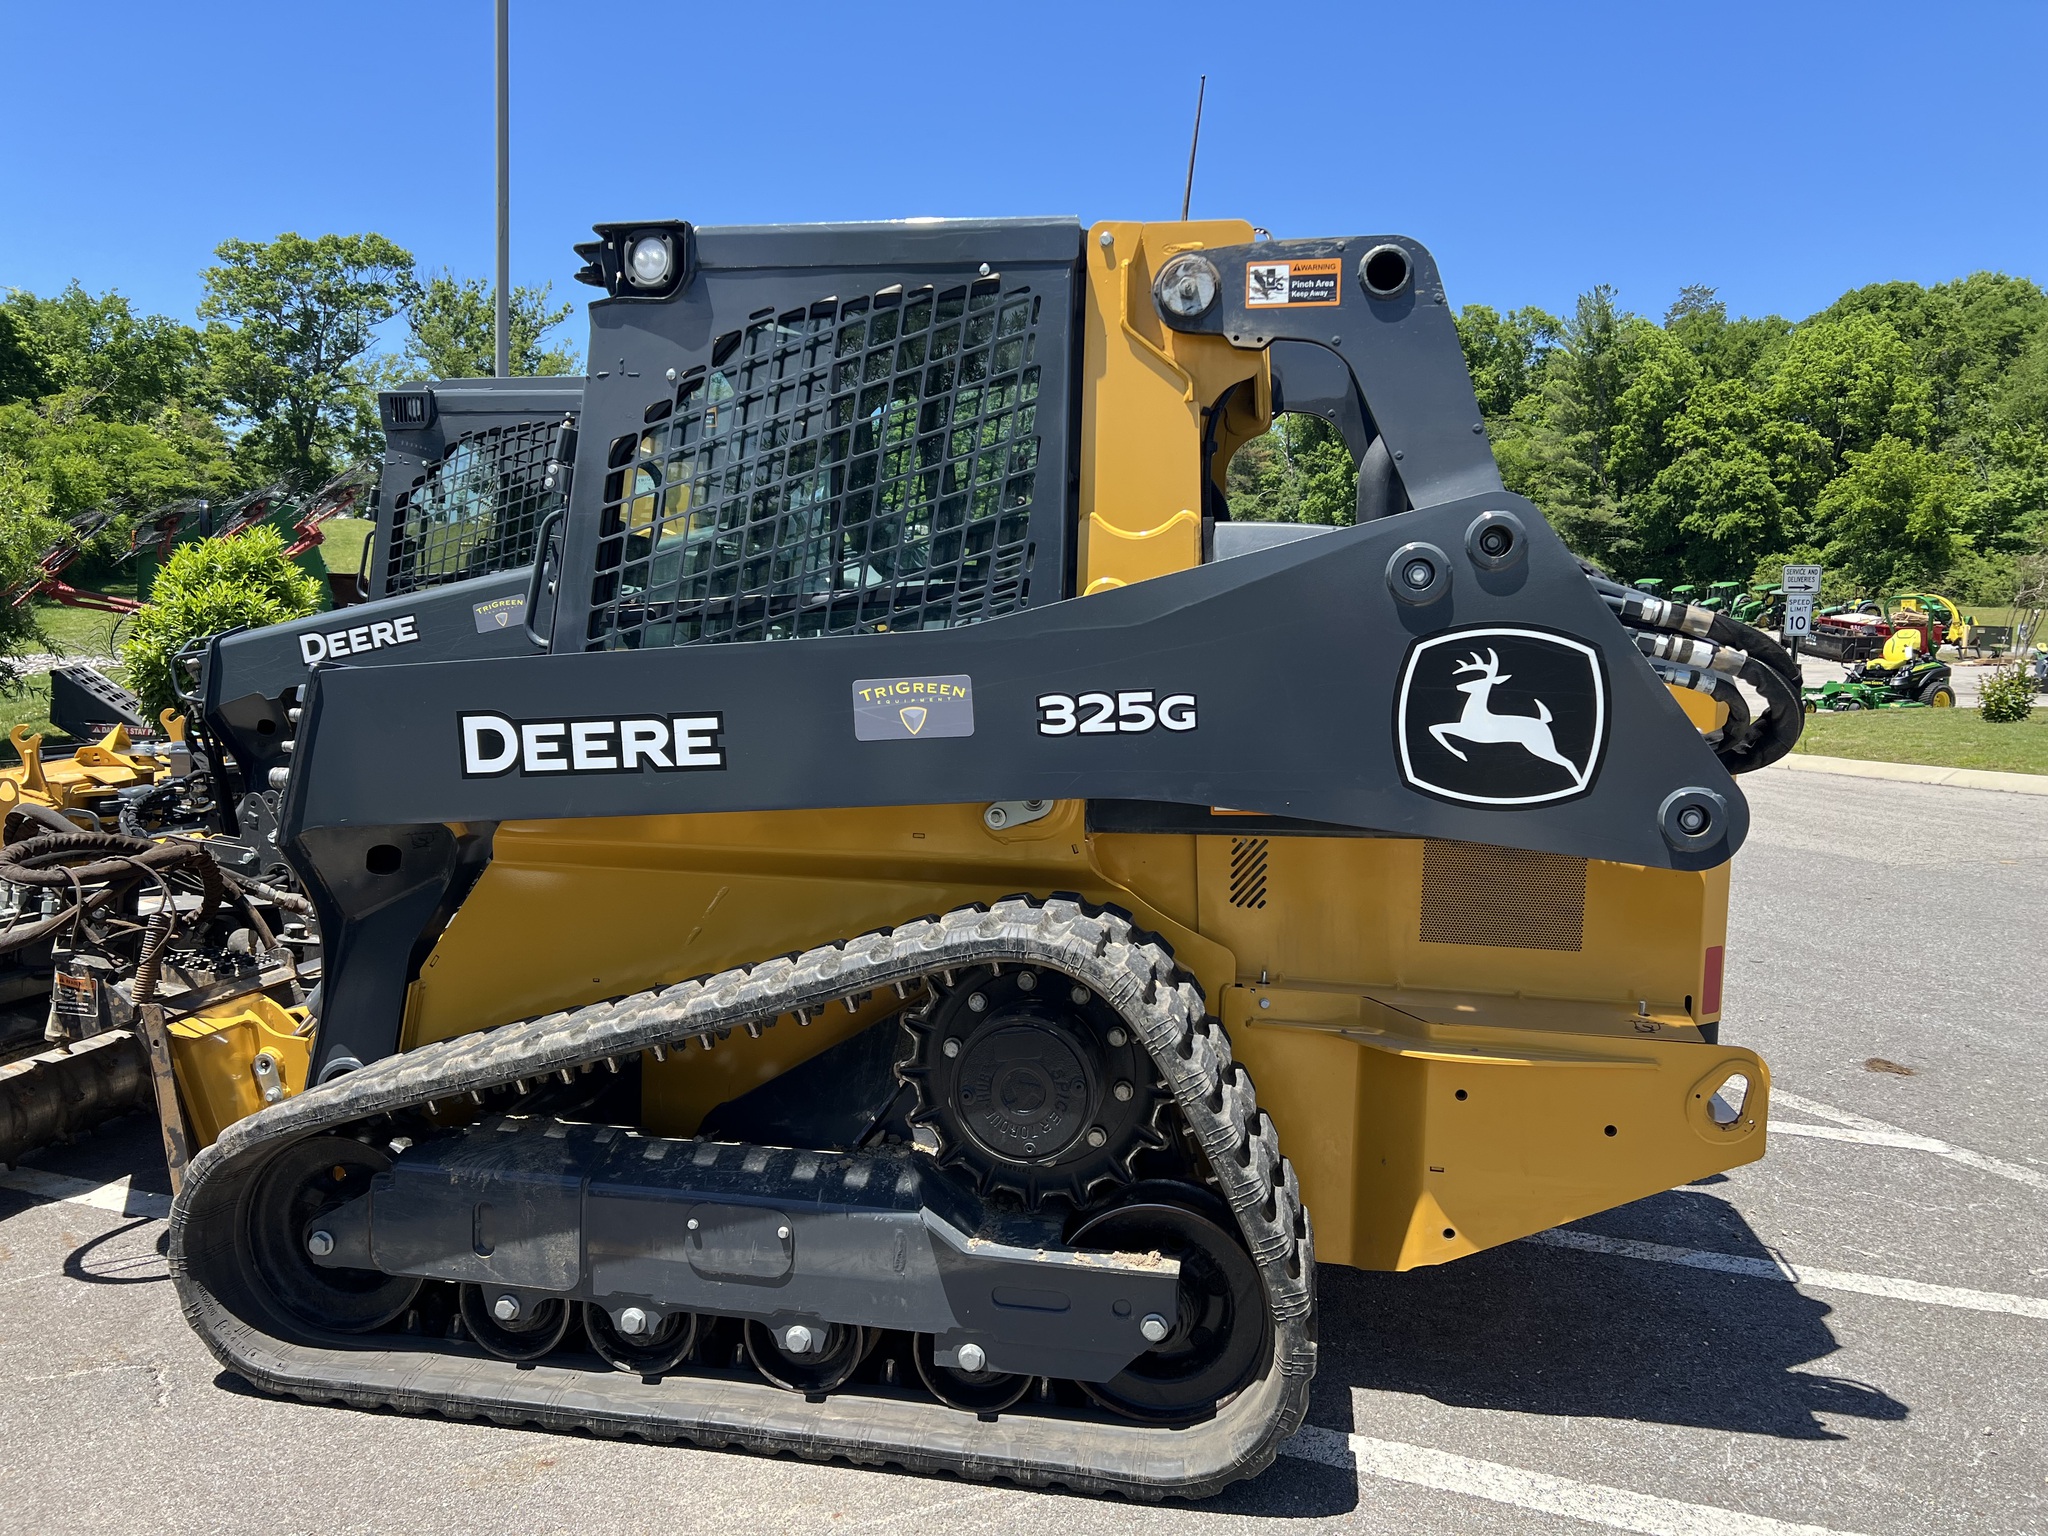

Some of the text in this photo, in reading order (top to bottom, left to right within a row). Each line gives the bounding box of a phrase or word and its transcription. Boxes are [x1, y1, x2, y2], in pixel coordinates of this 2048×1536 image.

[1300, 263, 1336, 271] WARNING
[1291, 280, 1314, 288] Pinch
[1790, 616, 1806, 630] 10
[299, 615, 418, 664] DEERE
[877, 697, 952, 705] EQUIPMENT
[1040, 692, 1196, 735] 325G
[464, 714, 722, 775] DEERE
